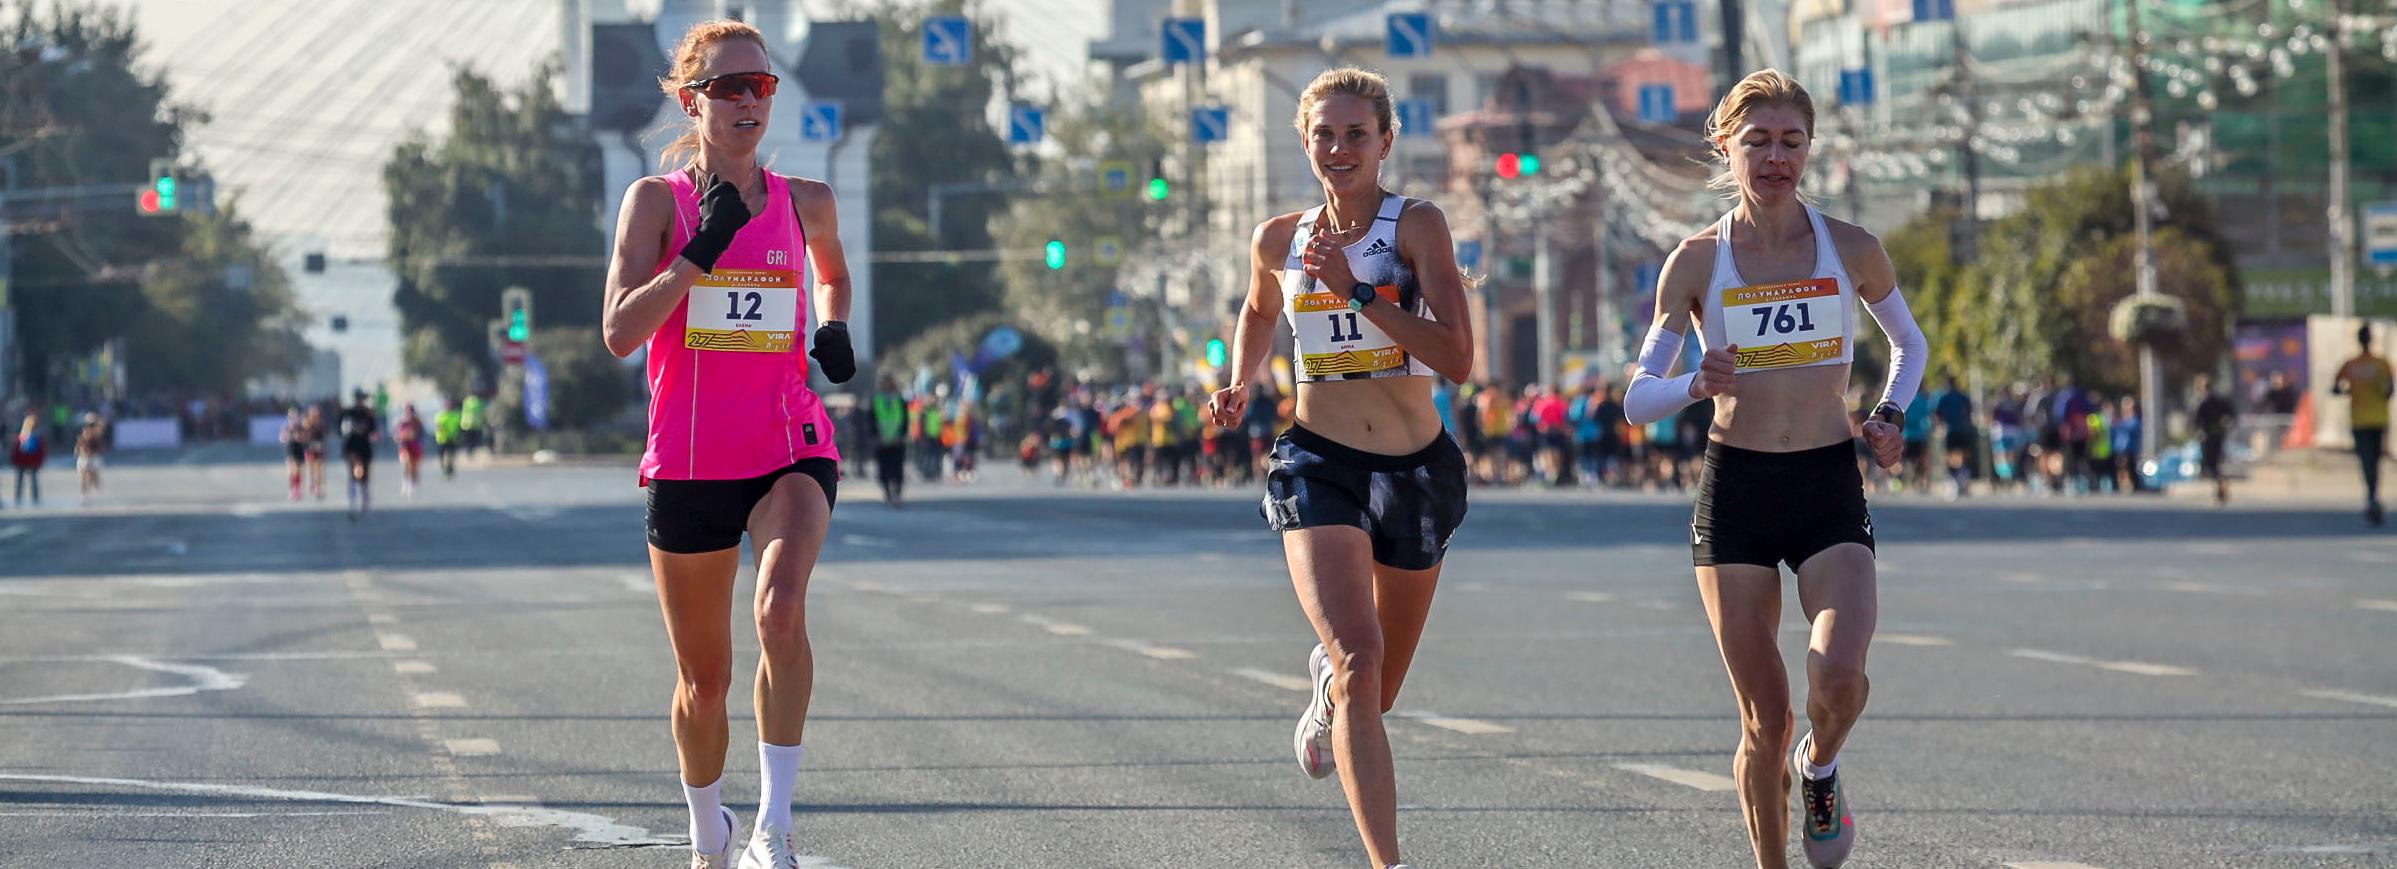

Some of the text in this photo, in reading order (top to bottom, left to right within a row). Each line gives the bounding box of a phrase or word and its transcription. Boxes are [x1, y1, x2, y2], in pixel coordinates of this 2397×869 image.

[767, 250, 787, 265] GRi
[1363, 246, 1392, 258] adidas
[1737, 286, 1817, 300] ПОЛУМАРАФОН
[726, 291, 762, 320] 12
[1752, 302, 1815, 337] 761
[1328, 313, 1363, 342] 11
[688, 332, 715, 347] 27
[1811, 340, 1838, 349] VIRA
[1372, 348, 1399, 357] VIRA
[1305, 358, 1324, 374] 27
